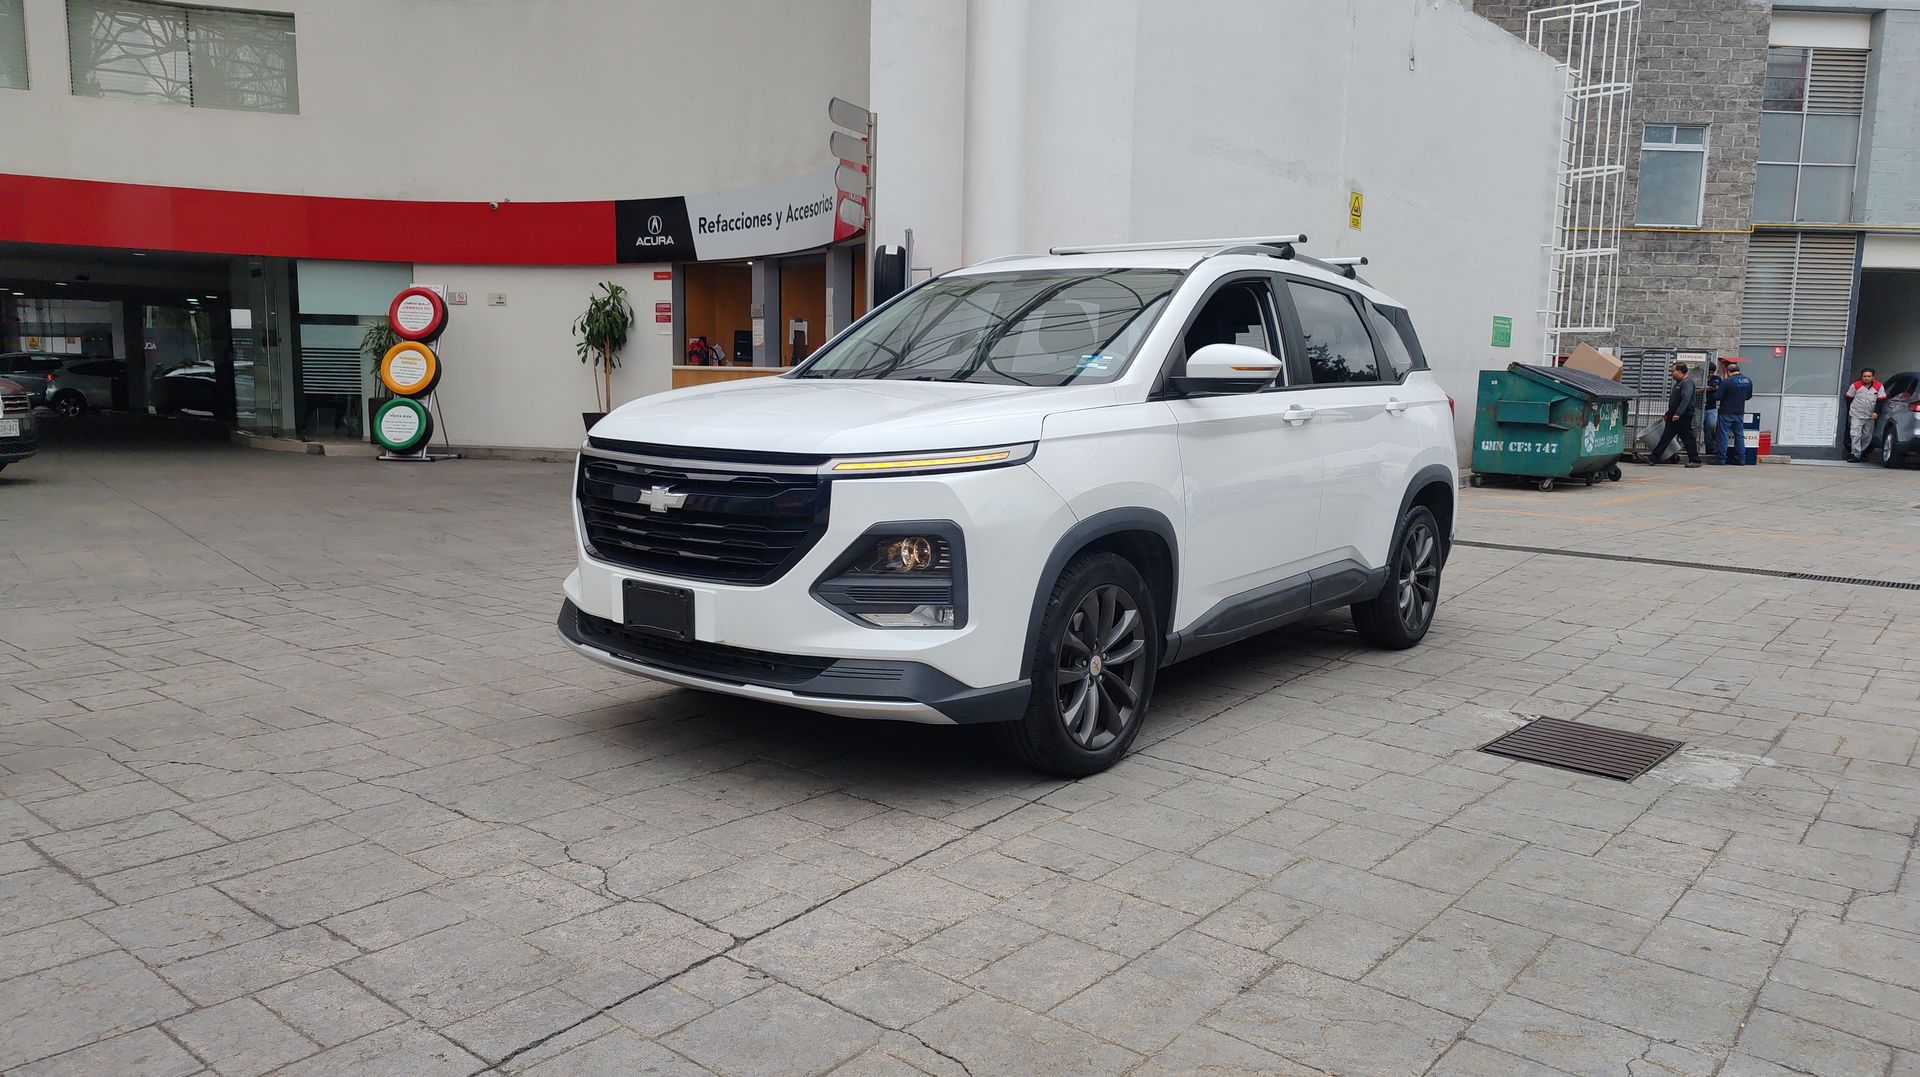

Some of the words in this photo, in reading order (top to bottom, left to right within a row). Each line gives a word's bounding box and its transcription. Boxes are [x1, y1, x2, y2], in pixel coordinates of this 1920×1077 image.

[698, 212, 773, 234] Refacciones
[775, 209, 783, 230] y
[786, 193, 833, 223] Accesorios
[635, 235, 675, 246] ACURA
[1508, 441, 1532, 452] CF3
[1535, 442, 1558, 454] 747
